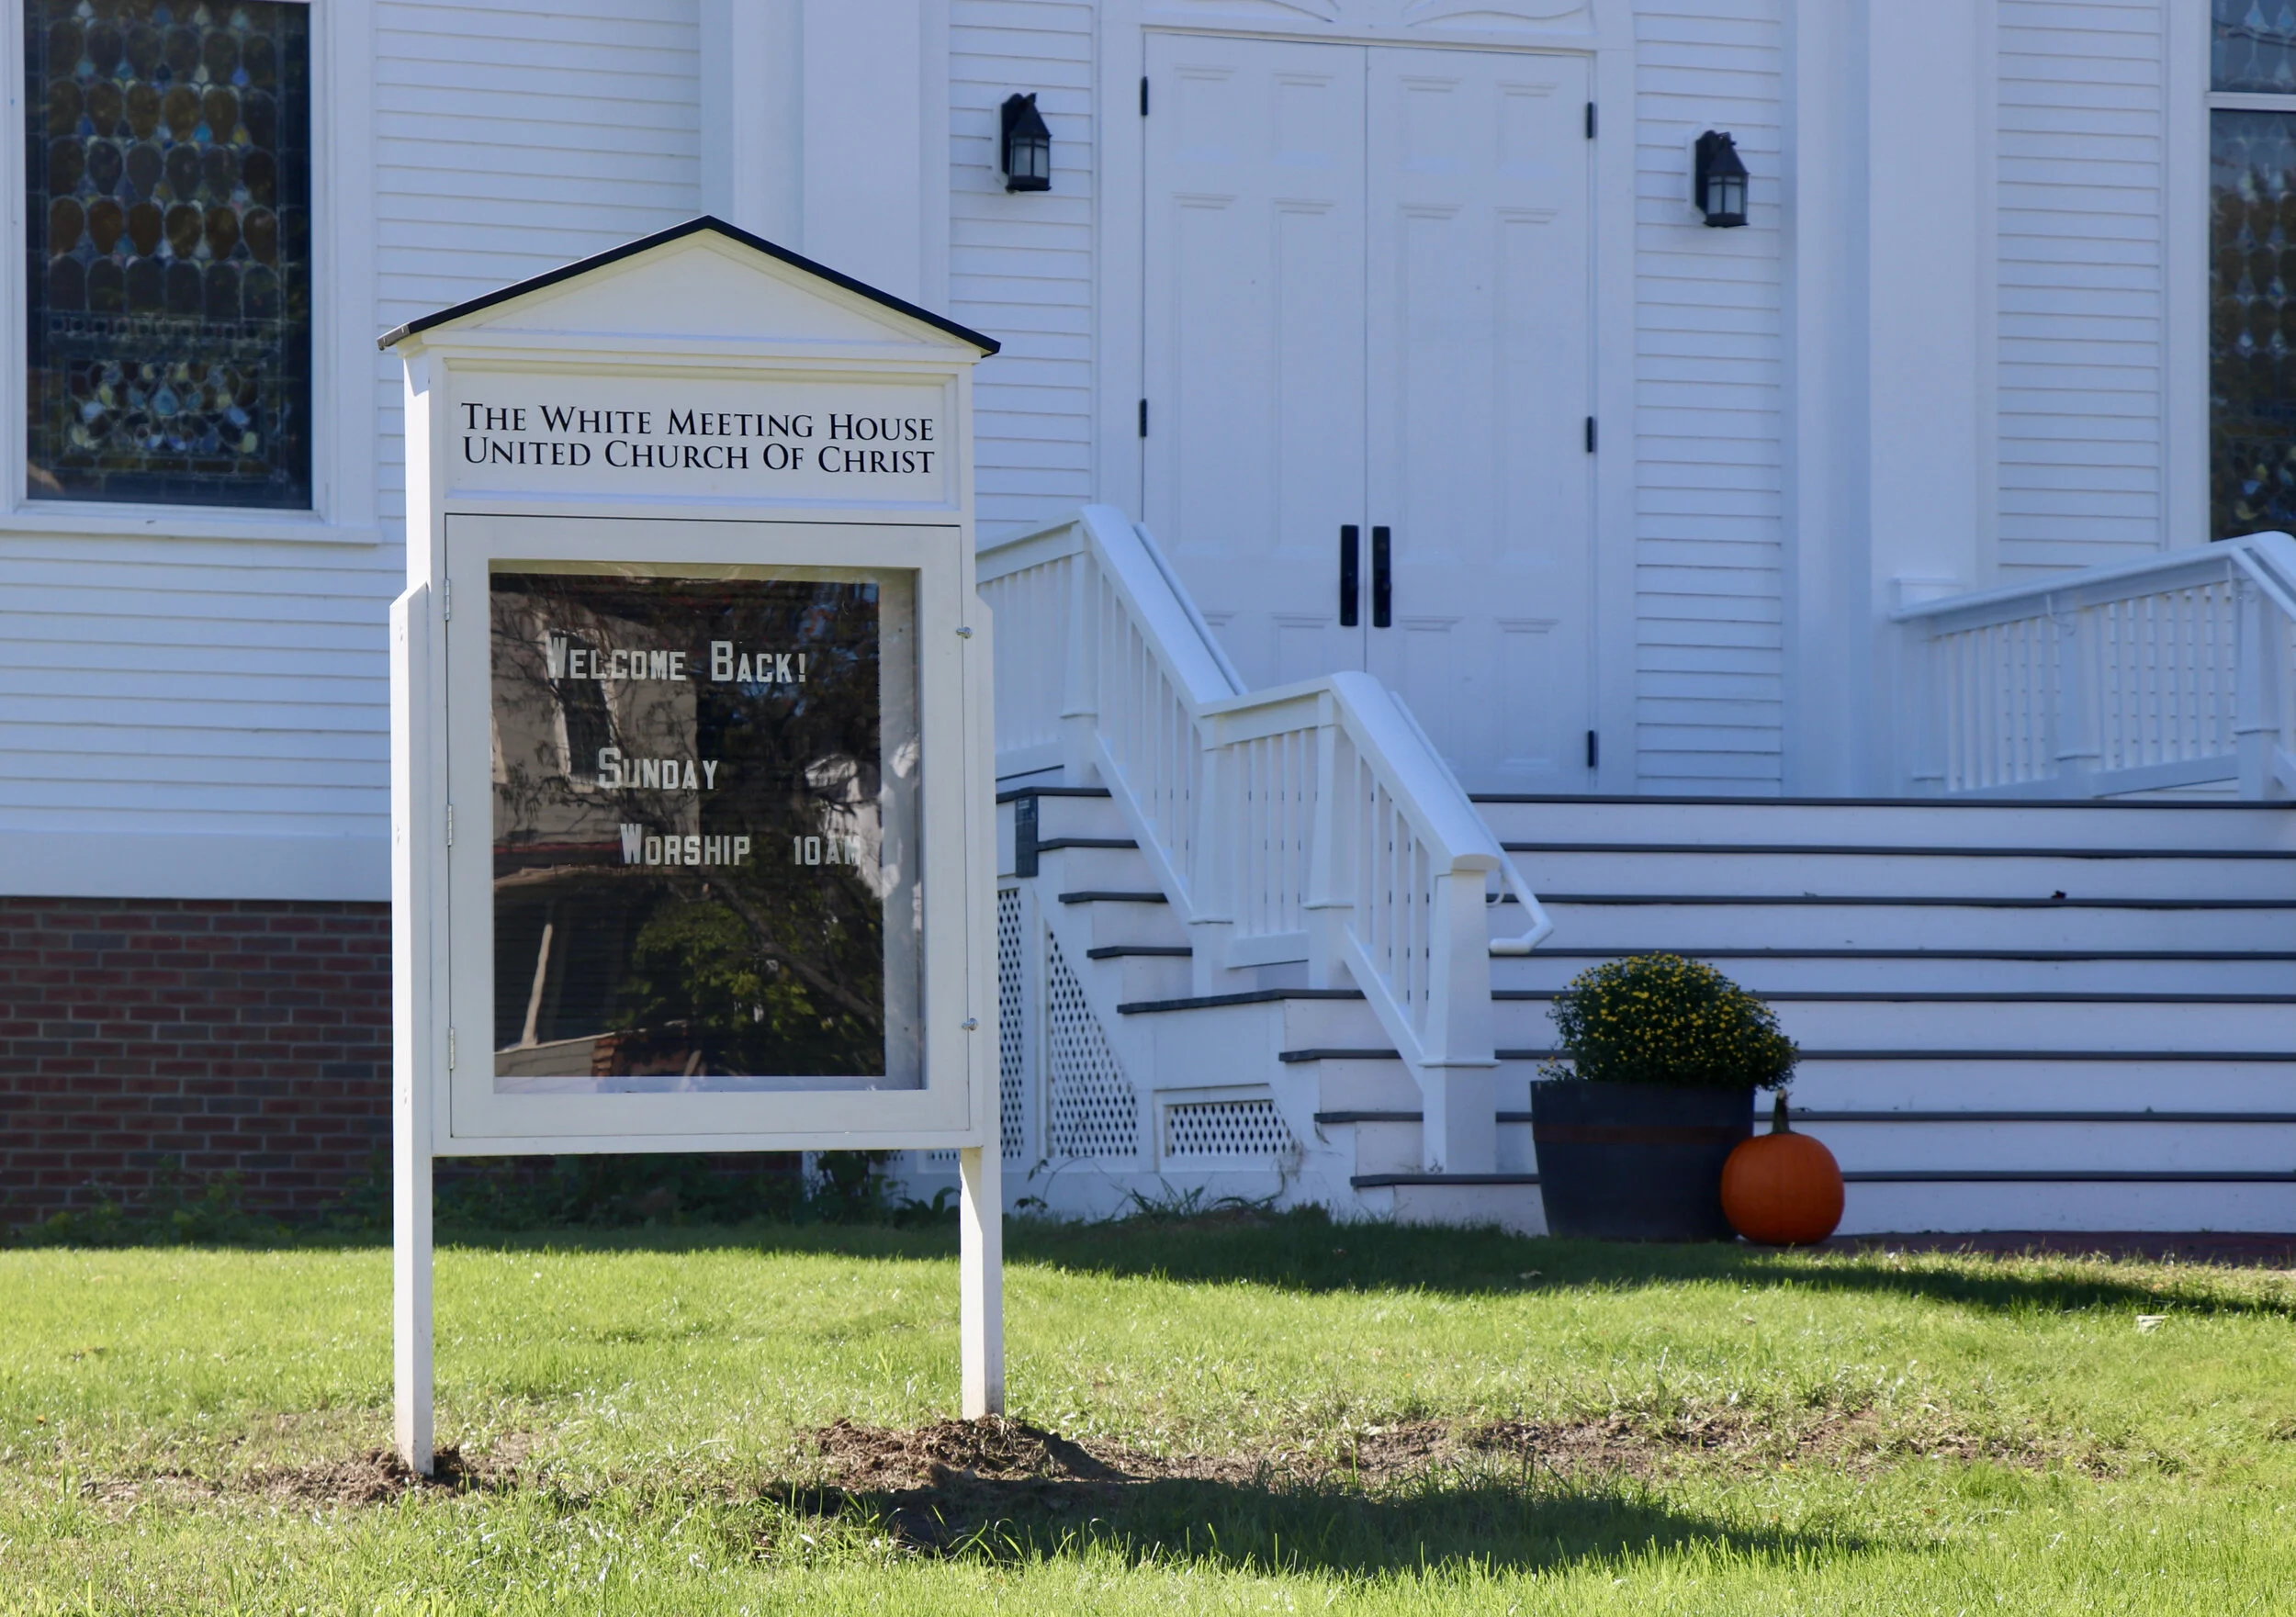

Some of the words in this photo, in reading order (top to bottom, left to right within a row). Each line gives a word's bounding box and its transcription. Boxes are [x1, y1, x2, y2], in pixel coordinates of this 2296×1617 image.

[461, 402, 526, 431] THE
[539, 406, 651, 434] WHITE
[667, 409, 814, 438] MEETING
[828, 413, 934, 441] HOUSE
[463, 436, 591, 466] UNITED
[604, 440, 748, 468] CHURCH
[763, 443, 805, 470] OF
[818, 446, 935, 474] CHRIST
[546, 637, 687, 679] WELCOME
[711, 641, 806, 682] BACK!
[598, 747, 718, 790] SUNDAY
[620, 823, 750, 865] WORSHIP
